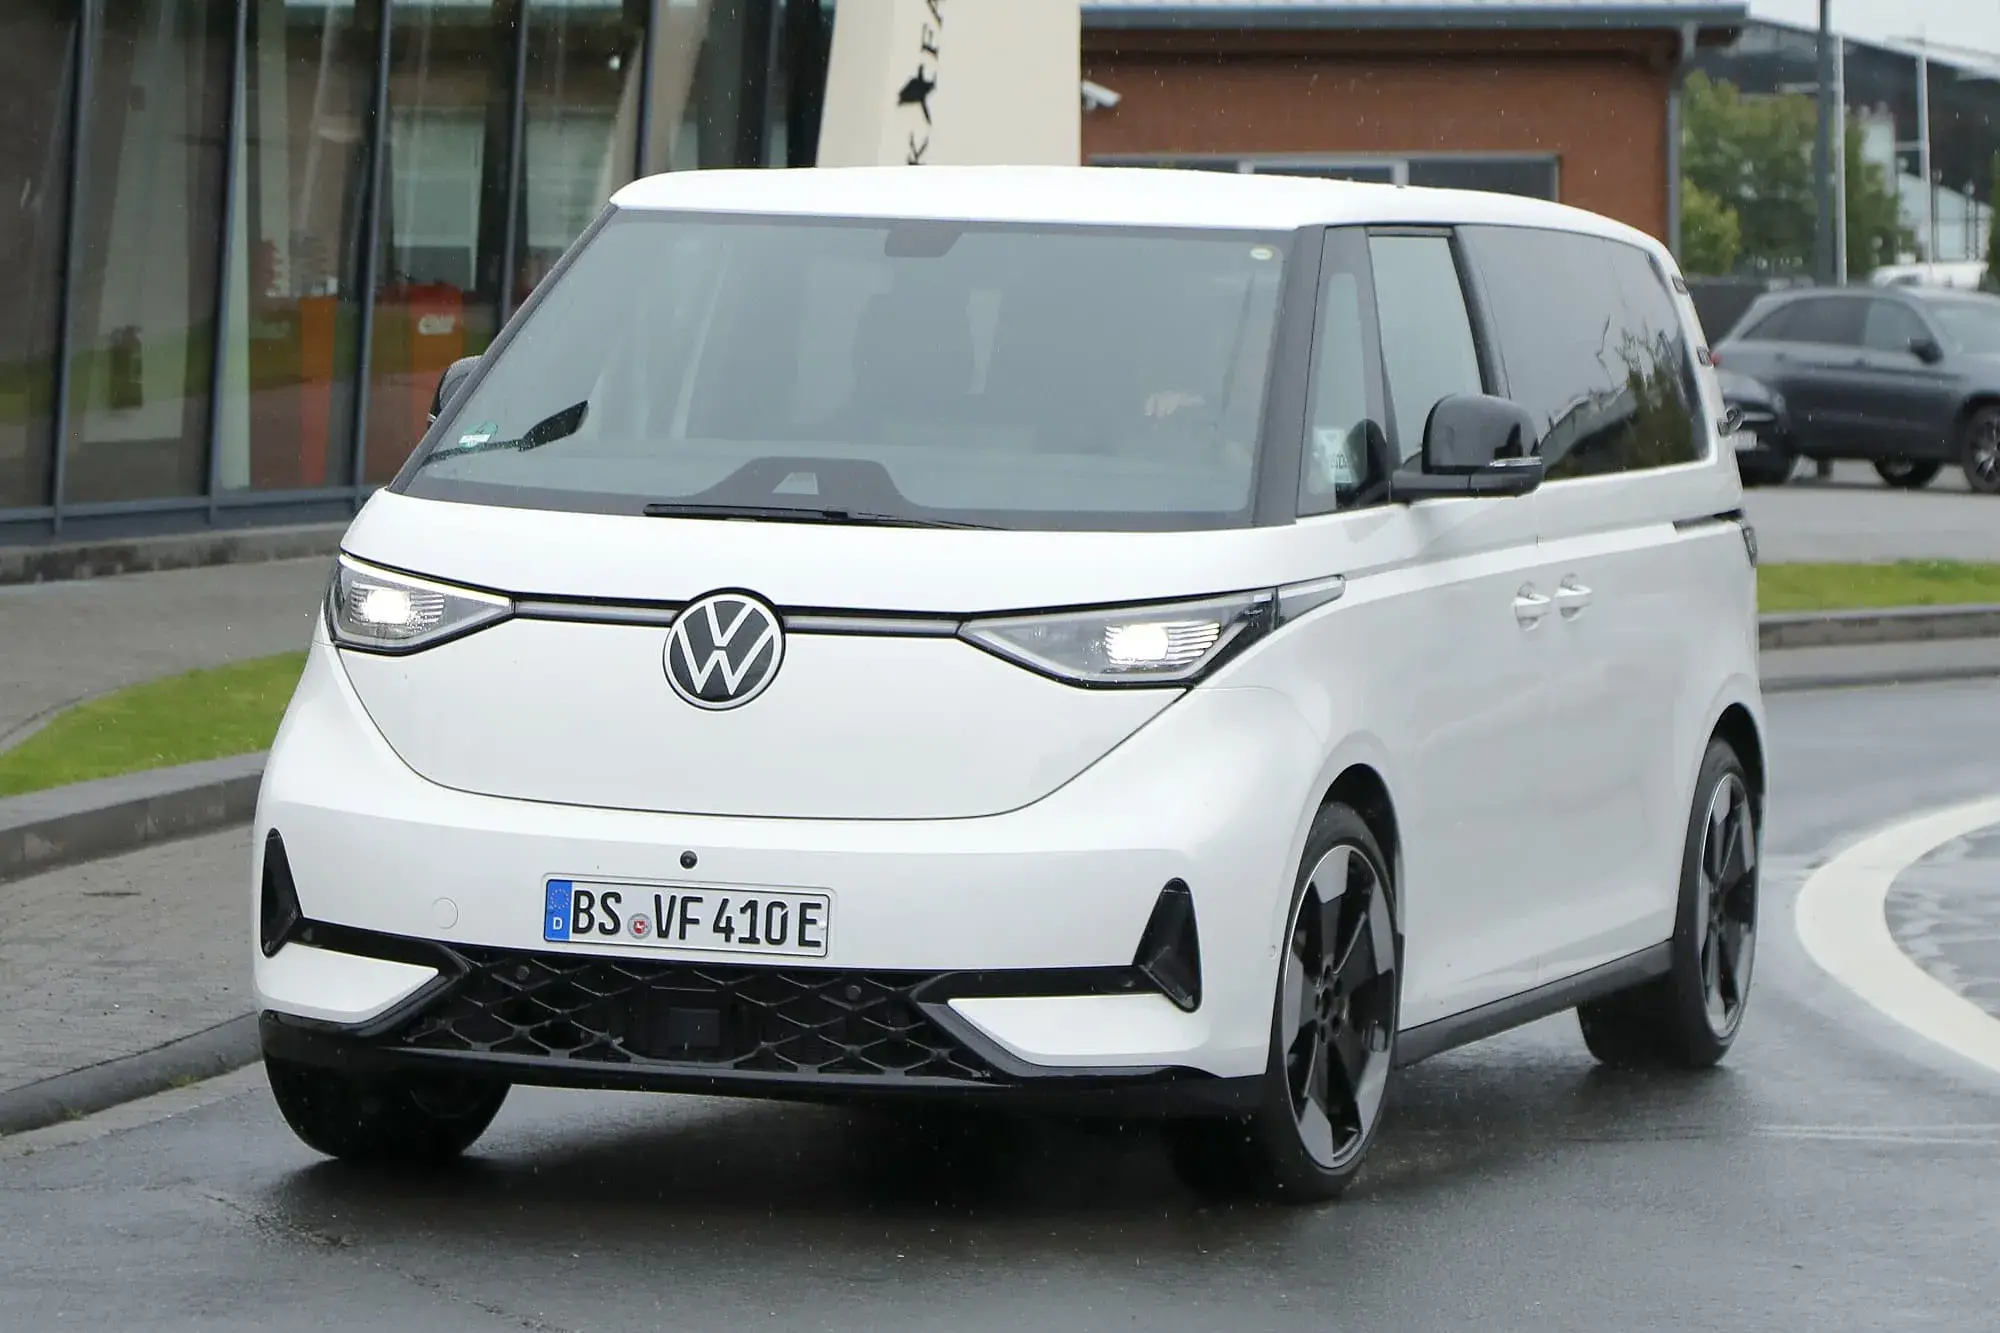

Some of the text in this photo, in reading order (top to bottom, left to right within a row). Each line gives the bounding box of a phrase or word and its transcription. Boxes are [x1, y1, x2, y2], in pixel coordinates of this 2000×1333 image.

[552, 916, 563, 931] D
[571, 889, 622, 936] BS
[654, 894, 703, 940] VF
